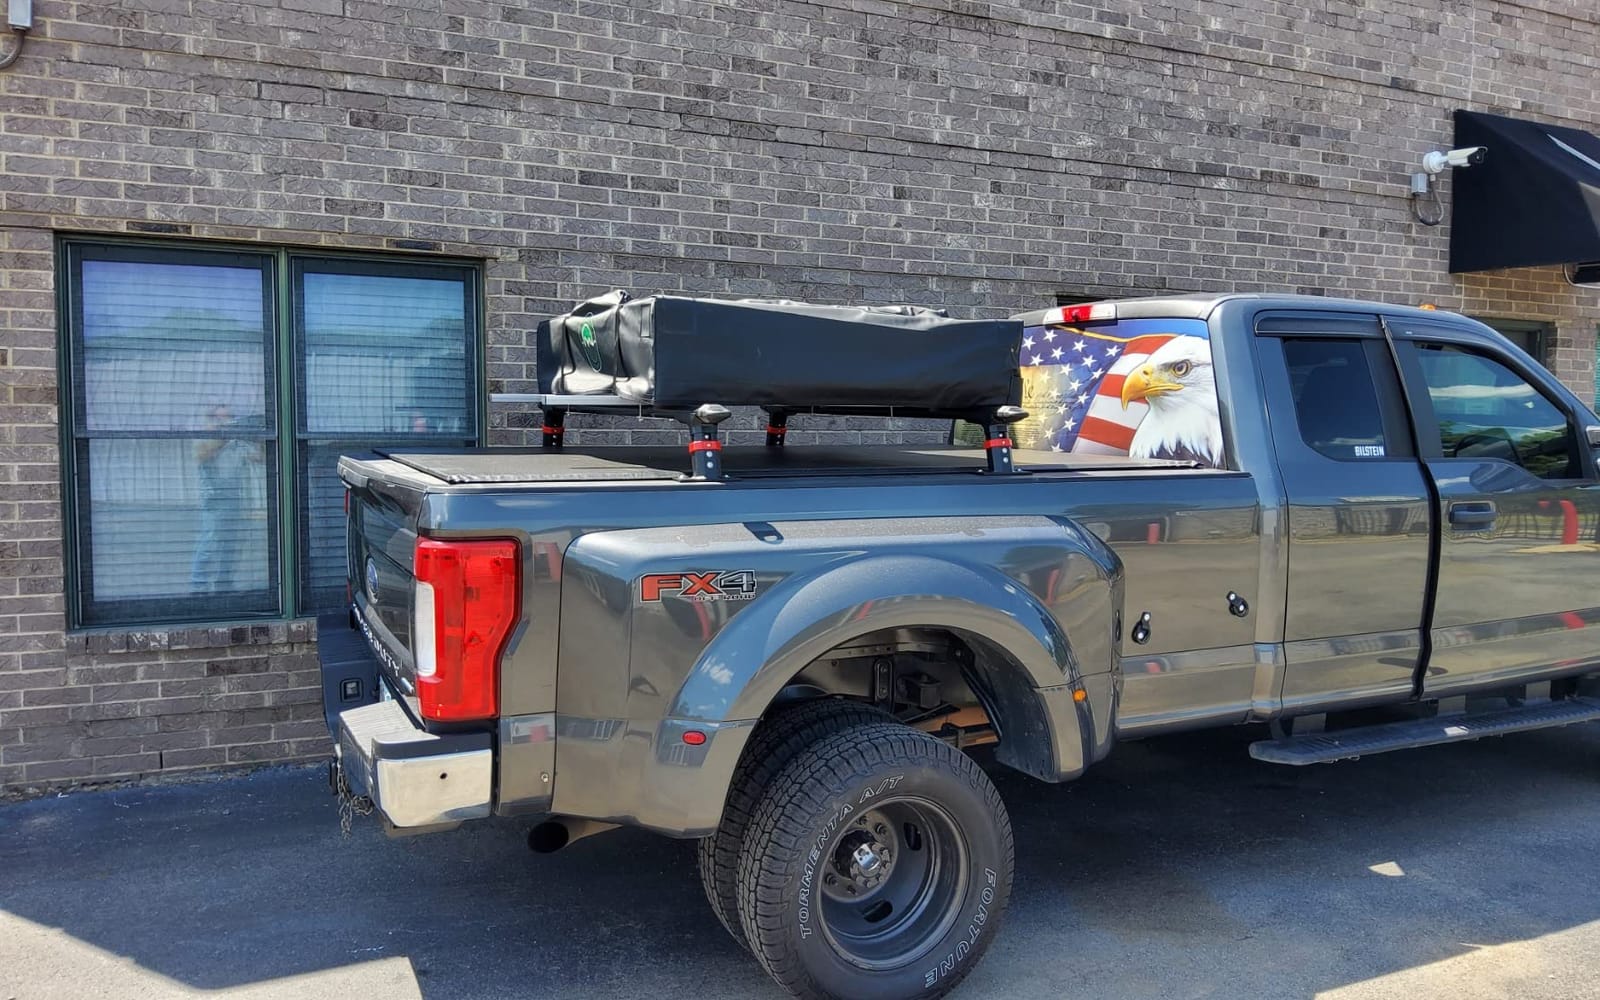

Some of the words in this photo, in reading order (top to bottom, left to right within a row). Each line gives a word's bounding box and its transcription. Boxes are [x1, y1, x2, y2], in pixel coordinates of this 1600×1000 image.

[1354, 445, 1385, 457] BILSTEIN
[640, 569, 757, 603] FX4
[799, 803, 854, 939] TORMENTA
[859, 775, 904, 804] A/T
[924, 867, 997, 988] FORTUNE
